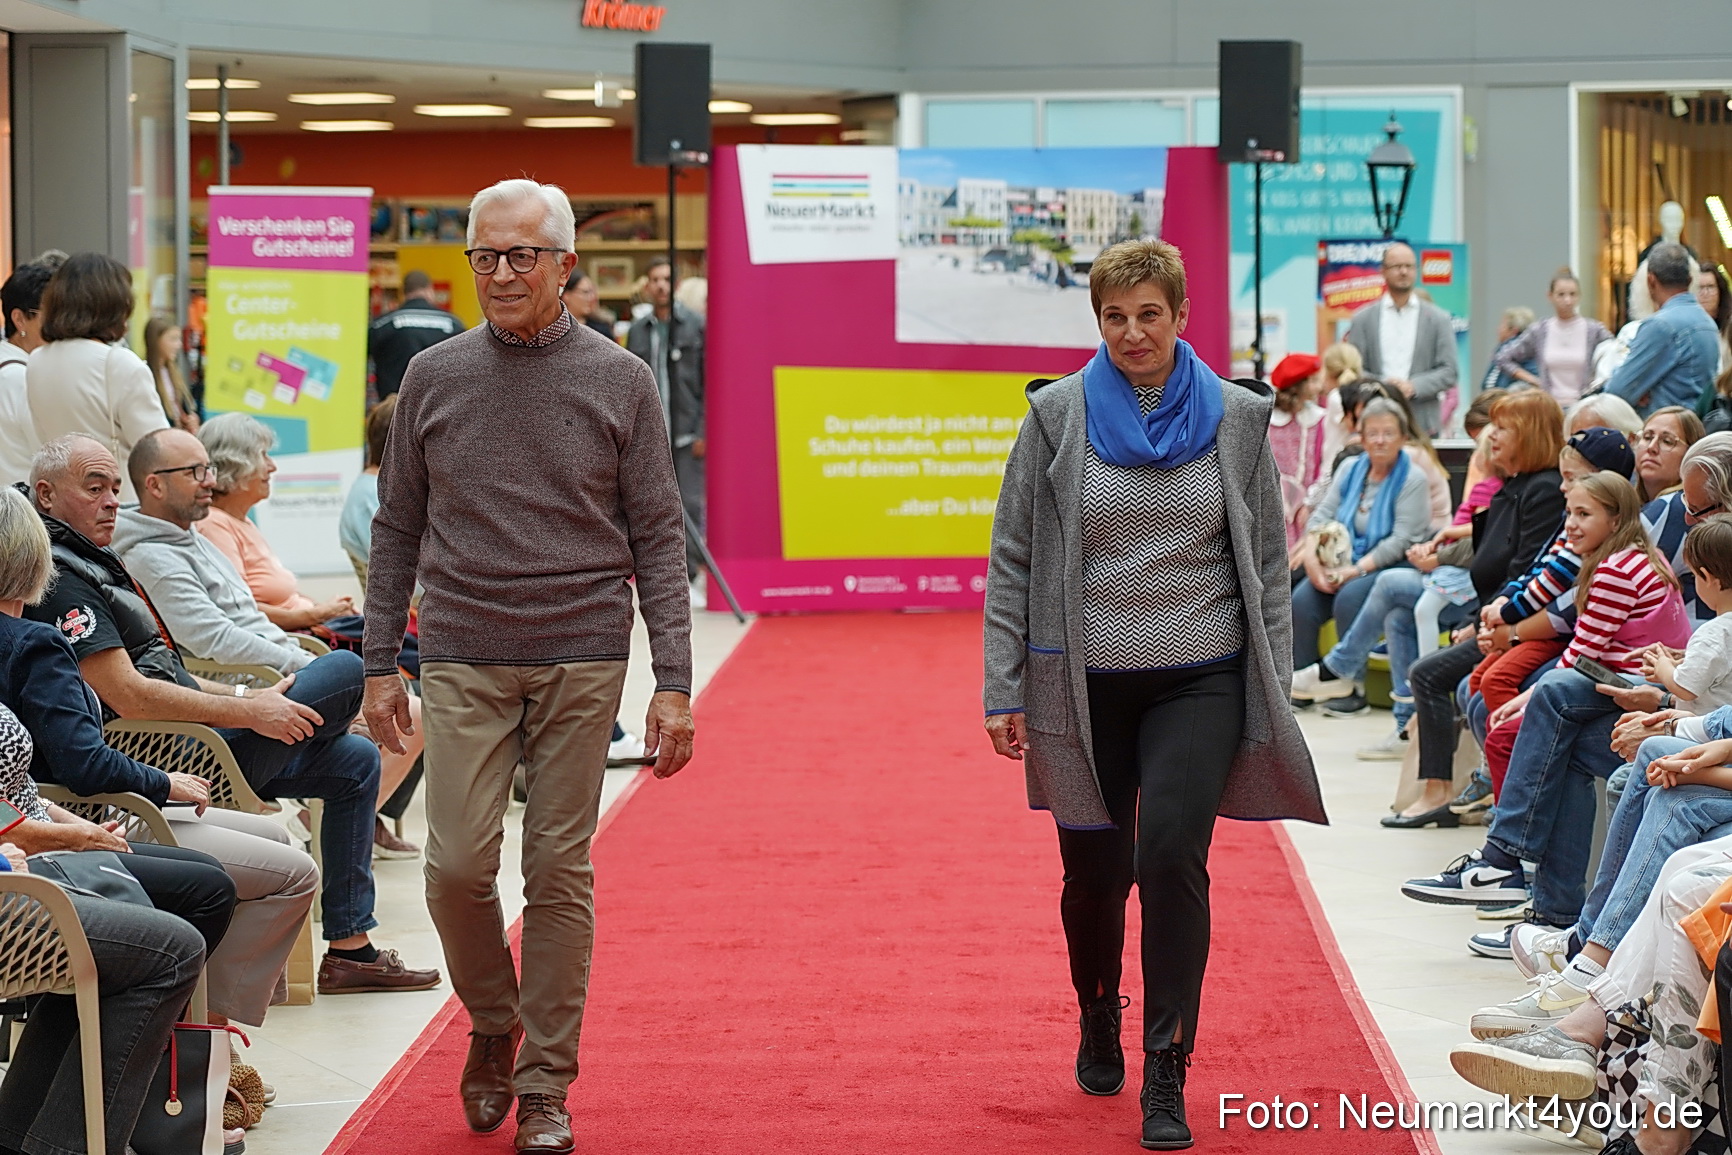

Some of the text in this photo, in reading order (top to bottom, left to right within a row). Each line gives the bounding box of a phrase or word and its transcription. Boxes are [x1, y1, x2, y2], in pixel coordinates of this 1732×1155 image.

[581, 0, 667, 31] Krömer
[766, 202, 876, 218] NeuerMarkt
[218, 216, 355, 236] Verschenken Sie
[252, 237, 355, 257] Gutscheine!
[1422, 259, 1451, 276] LEGO
[226, 294, 297, 315] Center-
[233, 319, 341, 340] Gutscheine
[825, 416, 849, 433] Du
[852, 415, 923, 433] würdest
[924, 416, 941, 436] ja
[944, 415, 988, 433] nicht
[991, 418, 1013, 432] an
[809, 438, 871, 455] Schuhe
[875, 437, 940, 455] kaufen,
[942, 438, 971, 454] ein
[823, 461, 857, 477] und
[859, 460, 919, 477] deinen
[943, 498, 967, 515] Du
